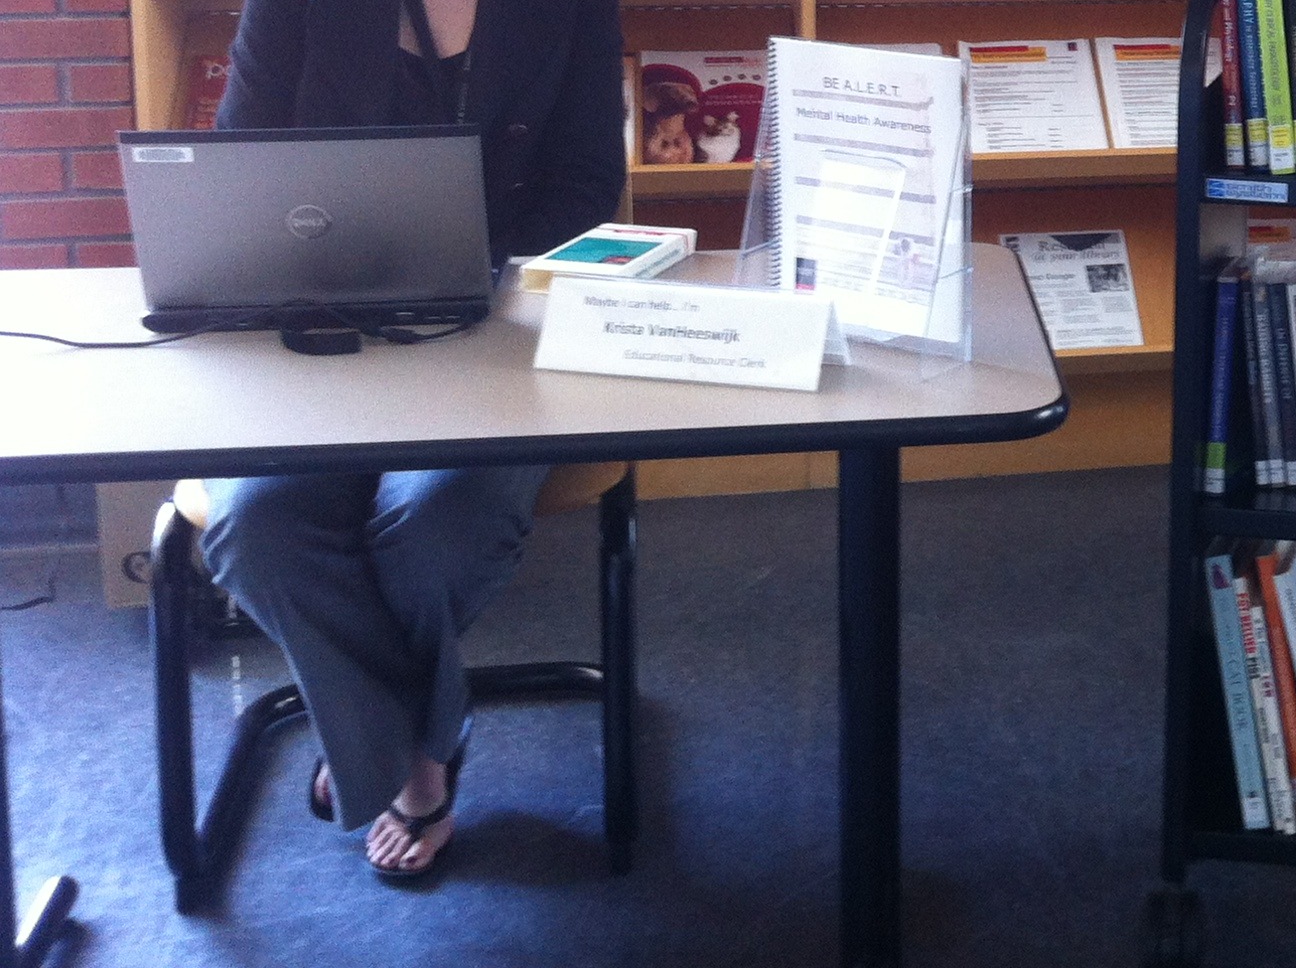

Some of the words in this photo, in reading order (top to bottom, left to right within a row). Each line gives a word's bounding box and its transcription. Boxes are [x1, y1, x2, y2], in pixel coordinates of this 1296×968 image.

[823, 76, 840, 90] BE
[796, 107, 833, 122] Mental
[836, 112, 871, 126] Health
[873, 116, 932, 134] Awareness
